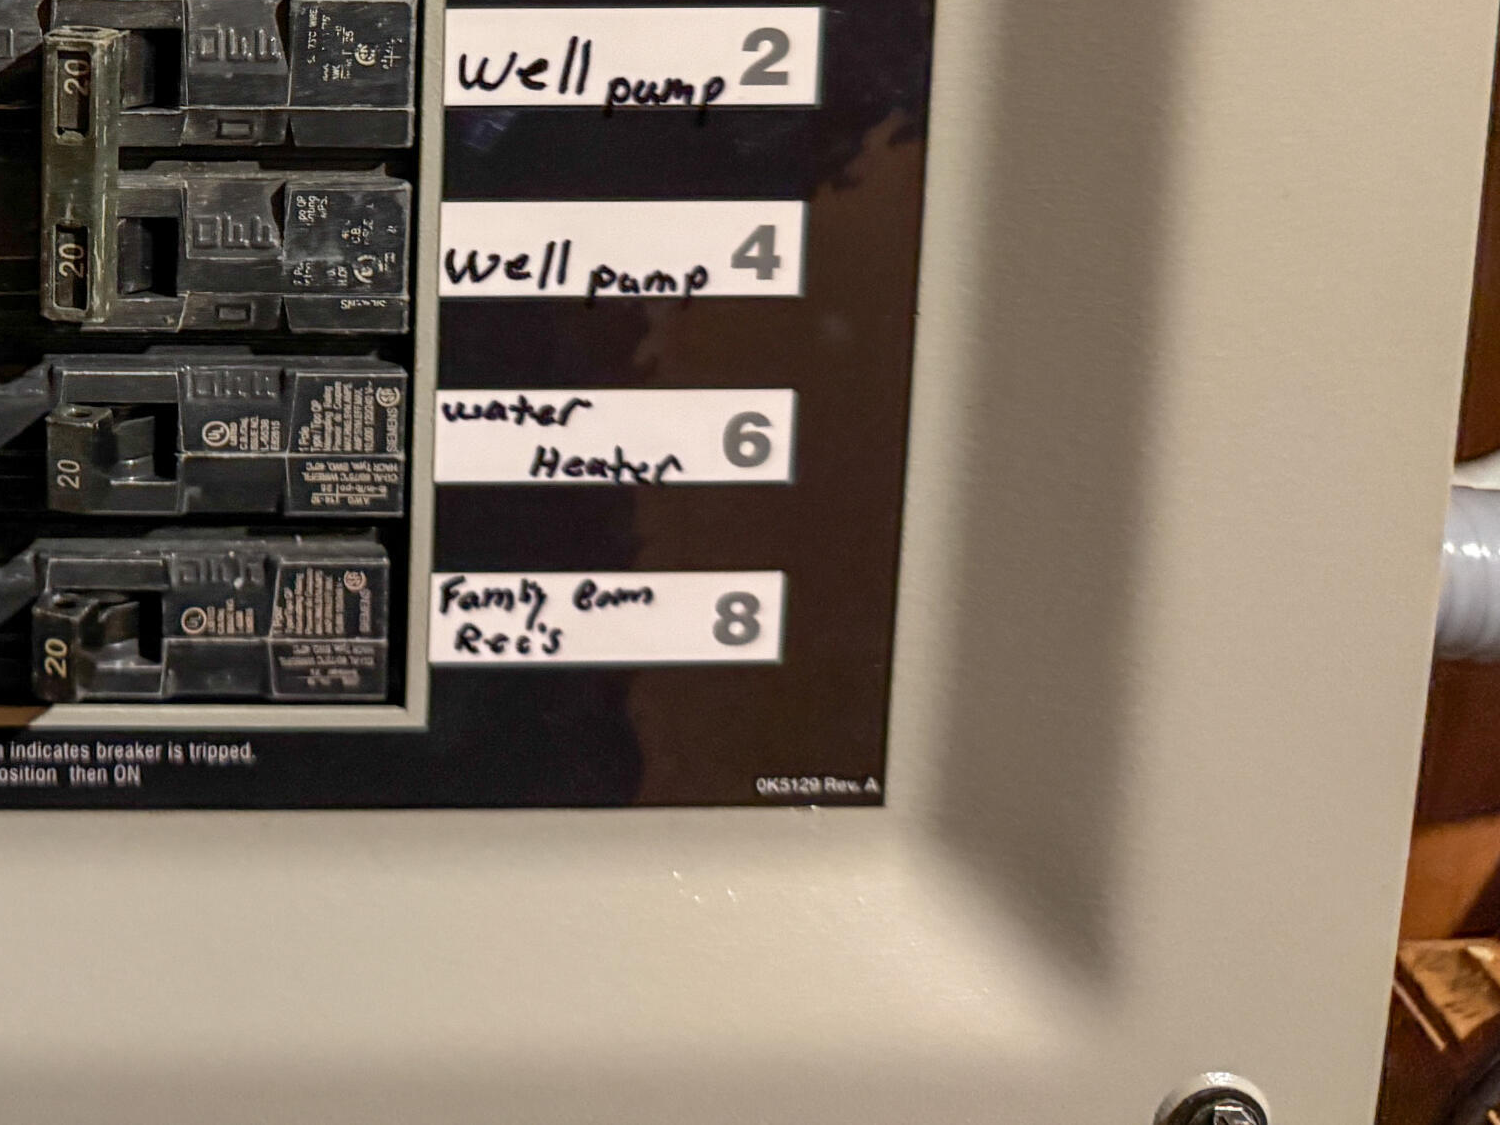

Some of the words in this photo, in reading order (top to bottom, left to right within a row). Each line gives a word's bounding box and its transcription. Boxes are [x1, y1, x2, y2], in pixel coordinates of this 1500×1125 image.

[739, 27, 790, 86] 2
[63, 59, 89, 96] 20
[604, 75, 725, 127] pump
[58, 242, 85, 277] 20
[730, 224, 781, 280] 4
[722, 411, 772, 468] 6
[56, 459, 81, 489] 20
[529, 445, 683, 486] Heater
[712, 591, 761, 646] 8
[44, 638, 68, 678] 20
[10, 741, 91, 762] indicates
[96, 741, 163, 762] breaker
[168, 741, 183, 762] is
[188, 741, 256, 764] tripped.
[68, 764, 108, 784] then
[114, 764, 142, 784] ON
[824, 777, 861, 794] Rev.
[864, 777, 880, 793] A
